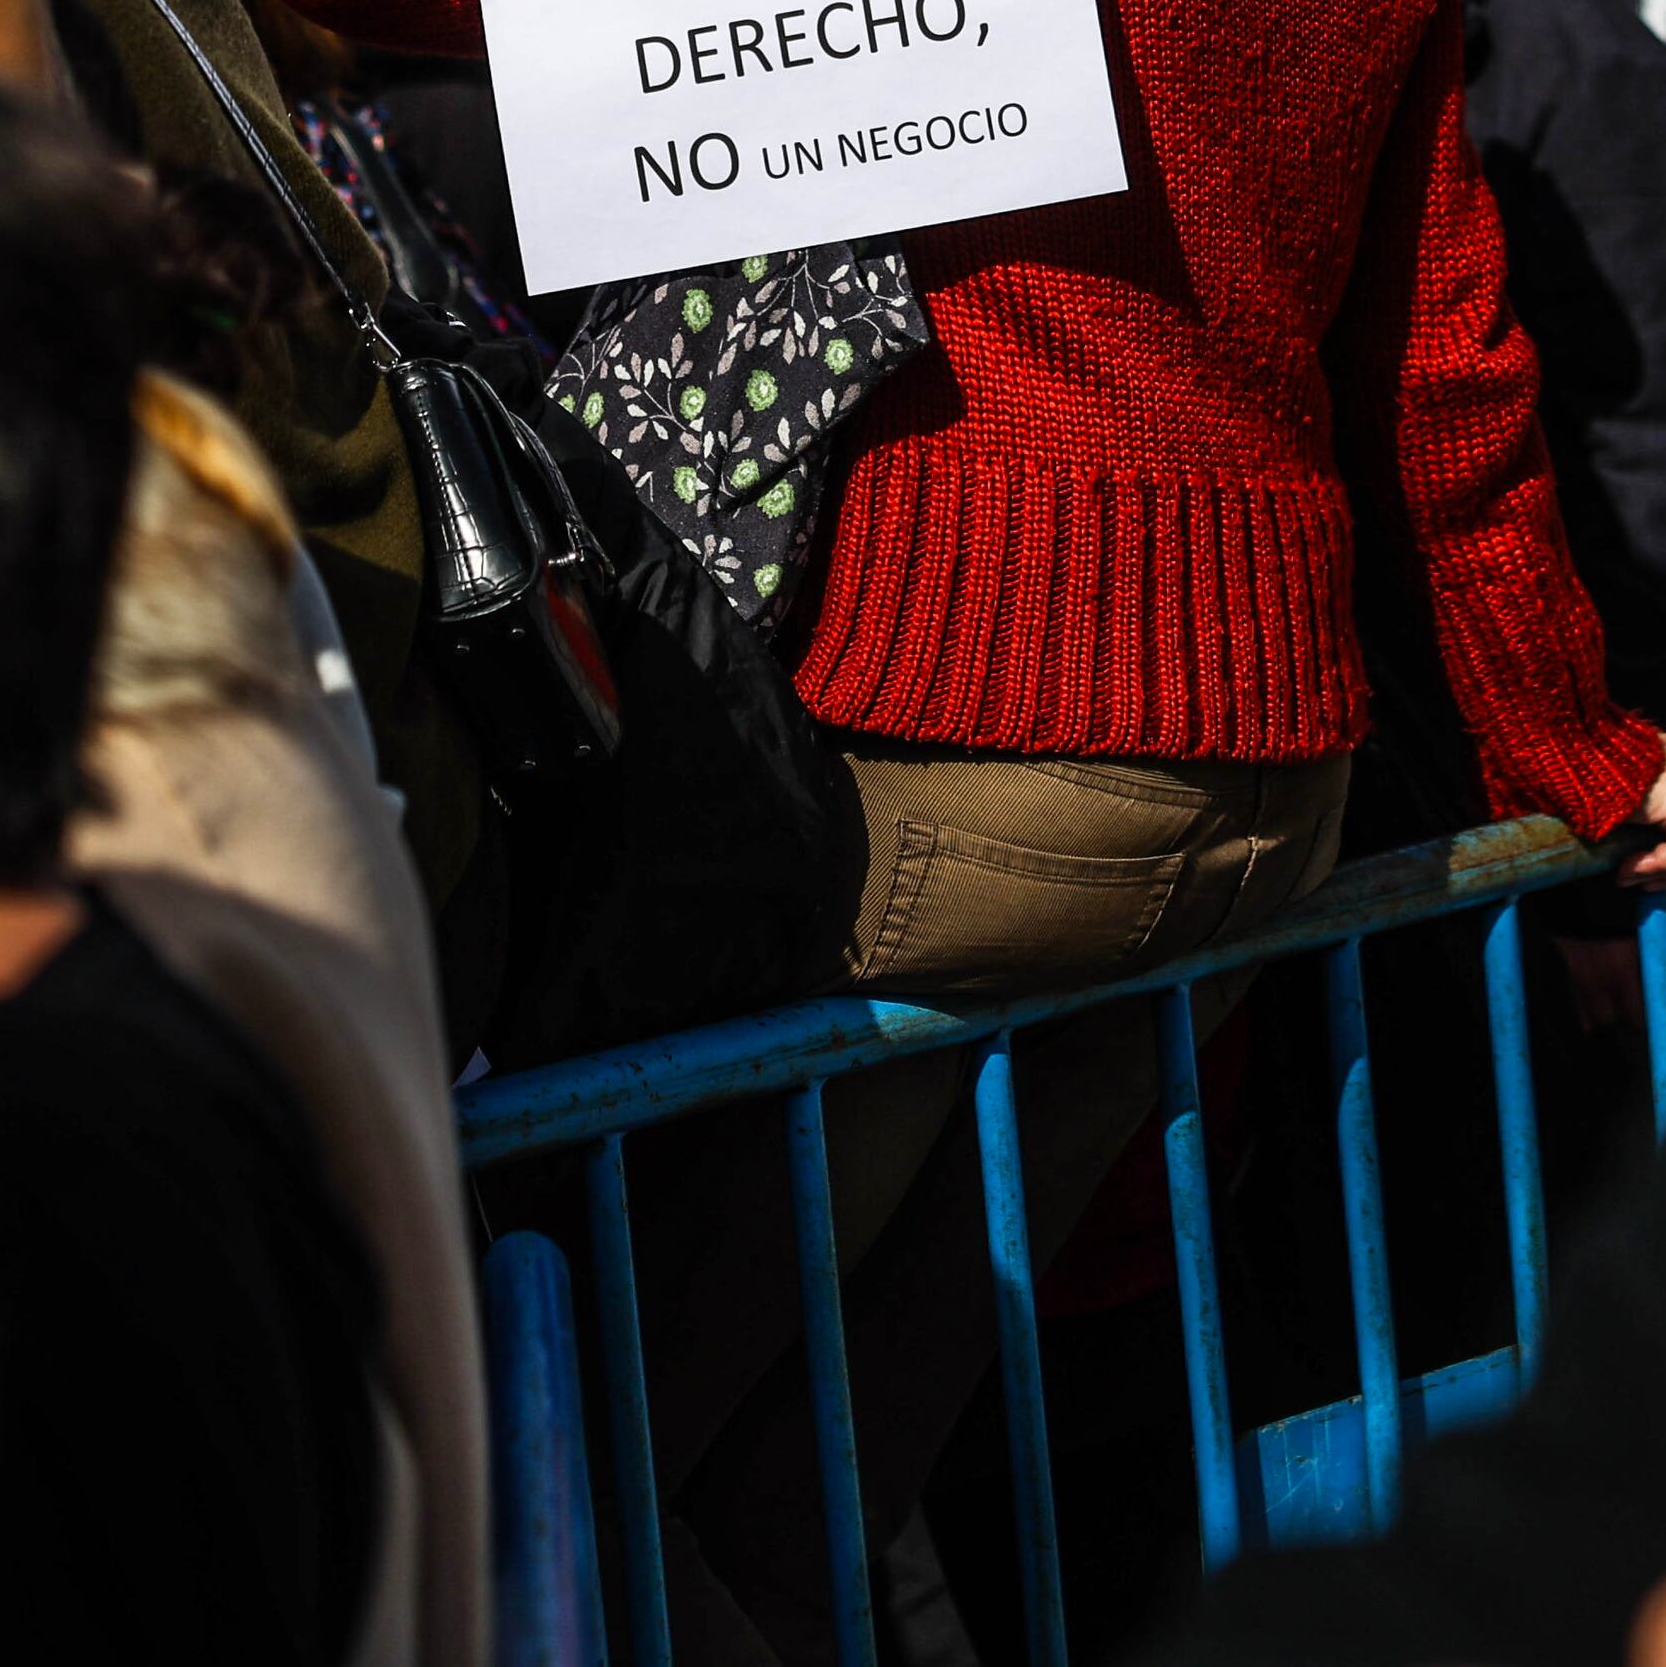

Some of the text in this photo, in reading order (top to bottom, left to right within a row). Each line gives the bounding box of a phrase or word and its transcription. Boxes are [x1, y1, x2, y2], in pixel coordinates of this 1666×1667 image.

[633, 102, 1029, 203] NO UN NEGOCIO
